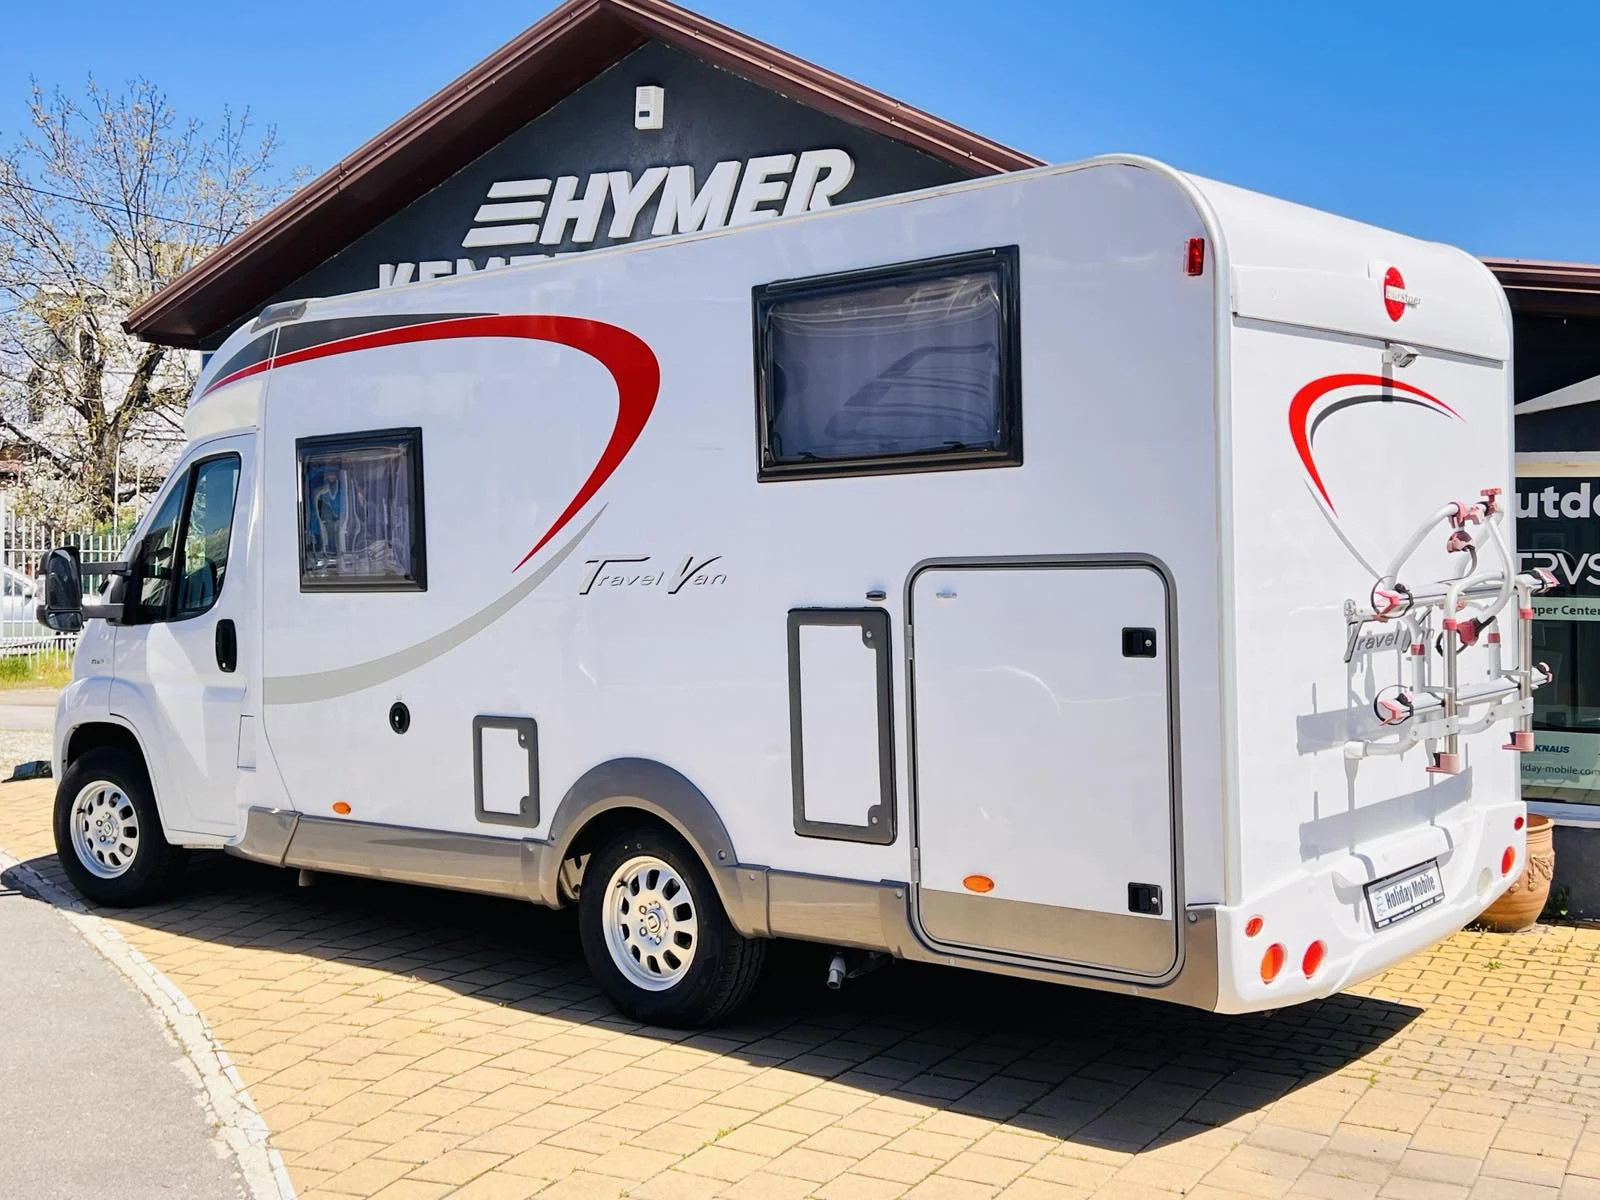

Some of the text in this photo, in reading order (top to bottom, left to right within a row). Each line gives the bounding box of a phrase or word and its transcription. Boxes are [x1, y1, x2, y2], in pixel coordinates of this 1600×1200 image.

[538, 148, 856, 246] HYMER
[579, 554, 727, 595] Travel Van
[1534, 744, 1570, 754] KNAUS
[1384, 883, 1414, 909] Holiday
[1411, 871, 1436, 898] Mobile
